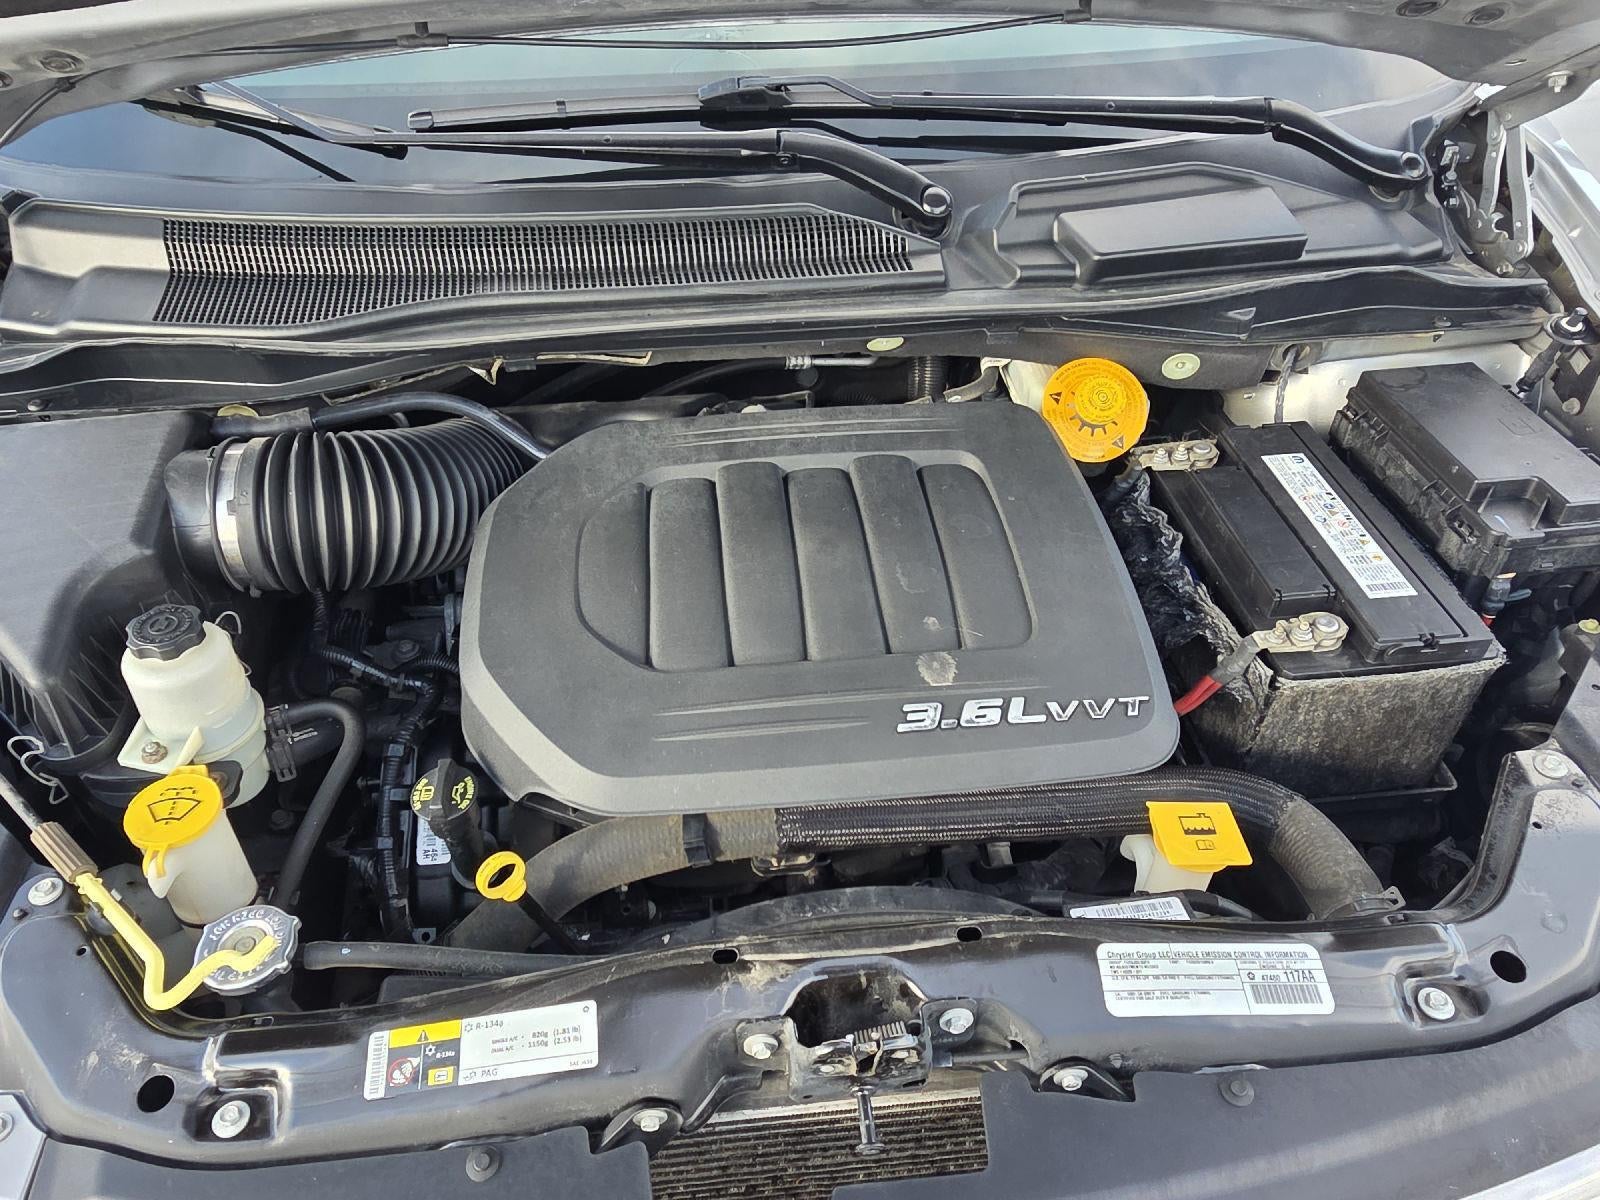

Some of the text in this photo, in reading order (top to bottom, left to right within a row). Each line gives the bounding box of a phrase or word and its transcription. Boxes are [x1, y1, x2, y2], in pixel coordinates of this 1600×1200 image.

[1046, 695, 1150, 722] VVT
[464, 776, 475, 798] ENGINE
[1107, 951, 1136, 960] Chrysler
[1136, 951, 1157, 959] Group
[1234, 951, 1263, 959] CONTROL
[1265, 951, 1309, 959] INFORMATION
[1283, 970, 1316, 983] 117AA
[476, 1020, 504, 1030] R-134a
[532, 1031, 549, 1039] 820g
[528, 1039, 549, 1049] 1150g
[480, 1068, 498, 1078] PAG
